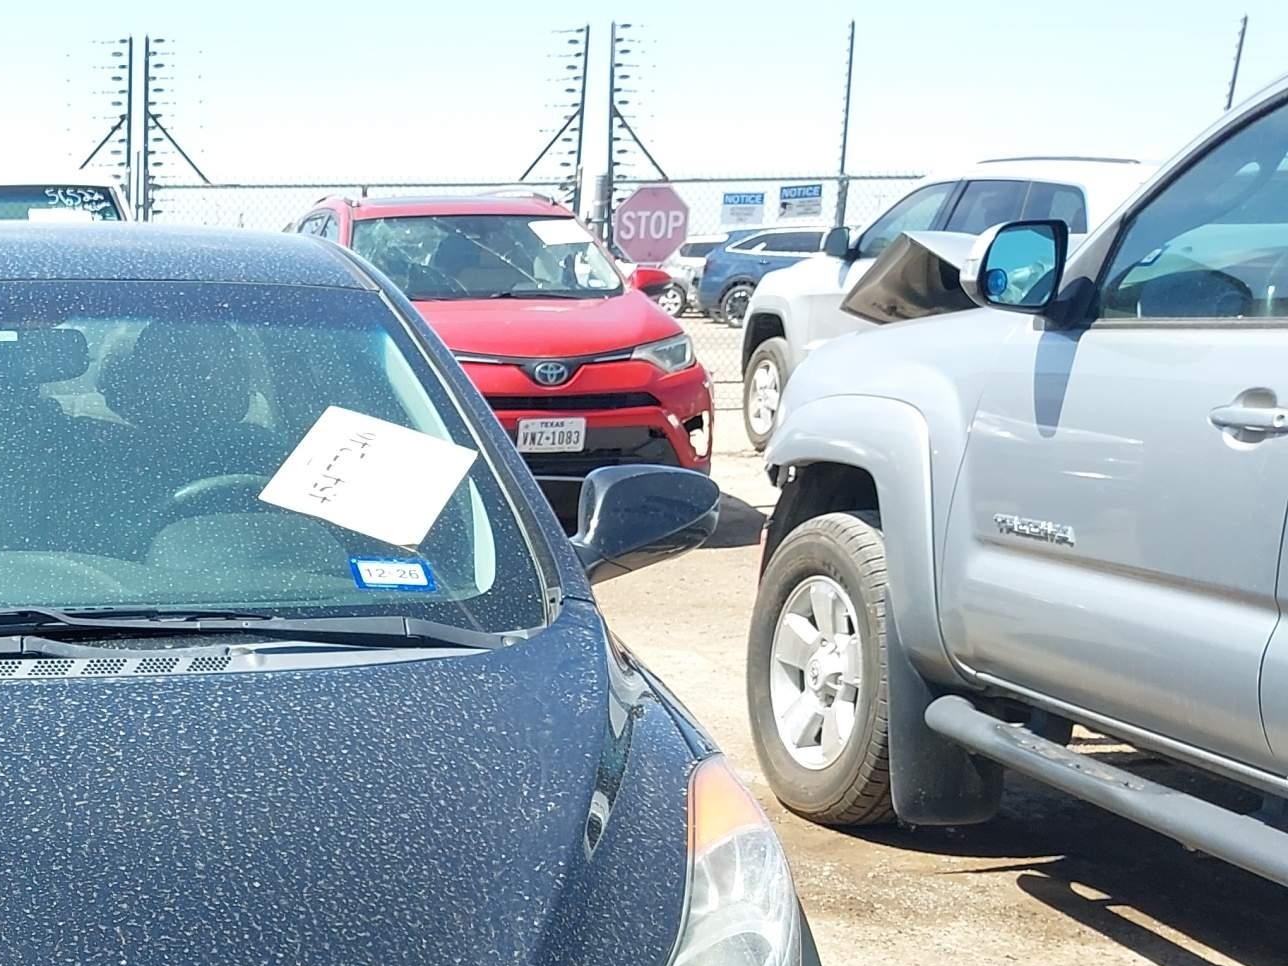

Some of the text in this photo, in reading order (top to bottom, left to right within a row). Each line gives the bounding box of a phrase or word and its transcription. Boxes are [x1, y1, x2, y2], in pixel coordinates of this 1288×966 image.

[781, 186, 820, 198] NOTICE
[725, 194, 762, 204] NOTICE
[620, 211, 684, 240] STOP
